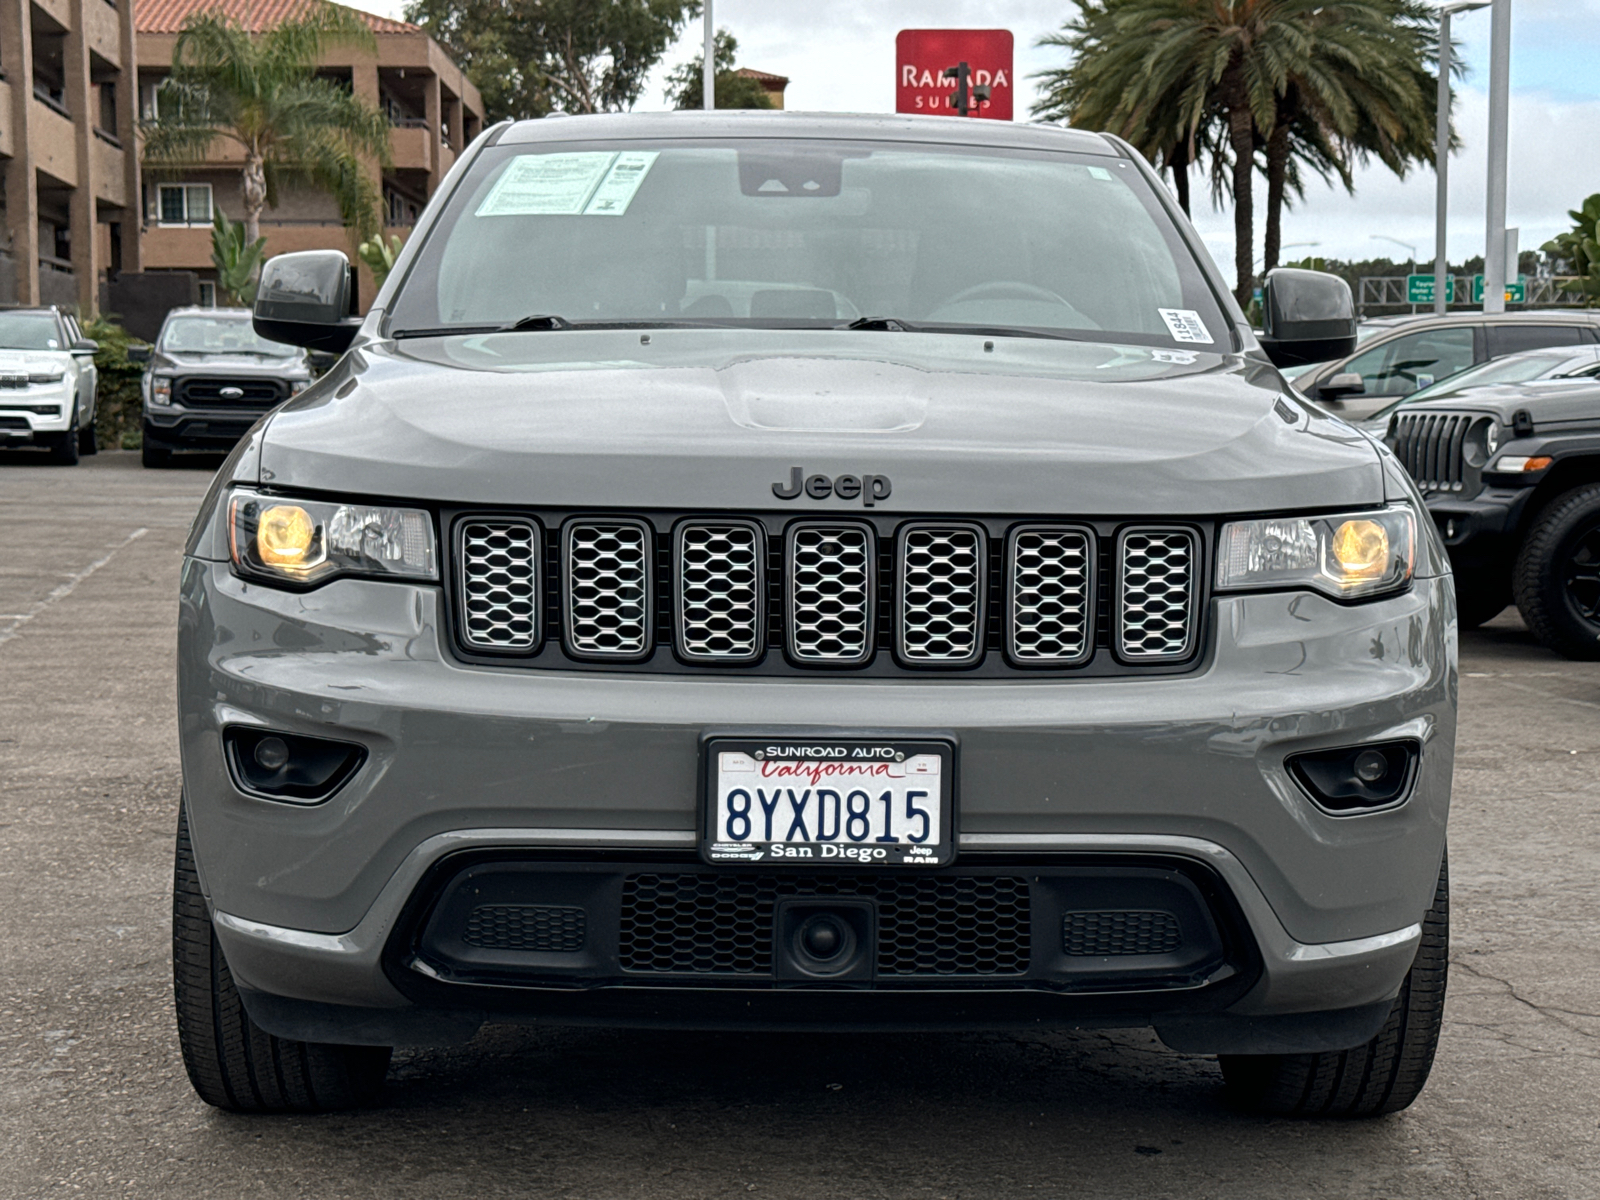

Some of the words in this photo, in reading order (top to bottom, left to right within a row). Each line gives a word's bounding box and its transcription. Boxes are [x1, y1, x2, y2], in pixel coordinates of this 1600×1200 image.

[915, 95, 991, 109] SUIES
[771, 466, 892, 507] Jeep
[765, 746, 847, 757] SUNROAD
[851, 747, 896, 758] AUTO
[761, 760, 906, 786] California
[726, 788, 931, 843] 8YXD815
[770, 844, 813, 858] San
[821, 844, 887, 862] Diego
[909, 845, 933, 856] Jeep
[903, 856, 939, 864] RAM
